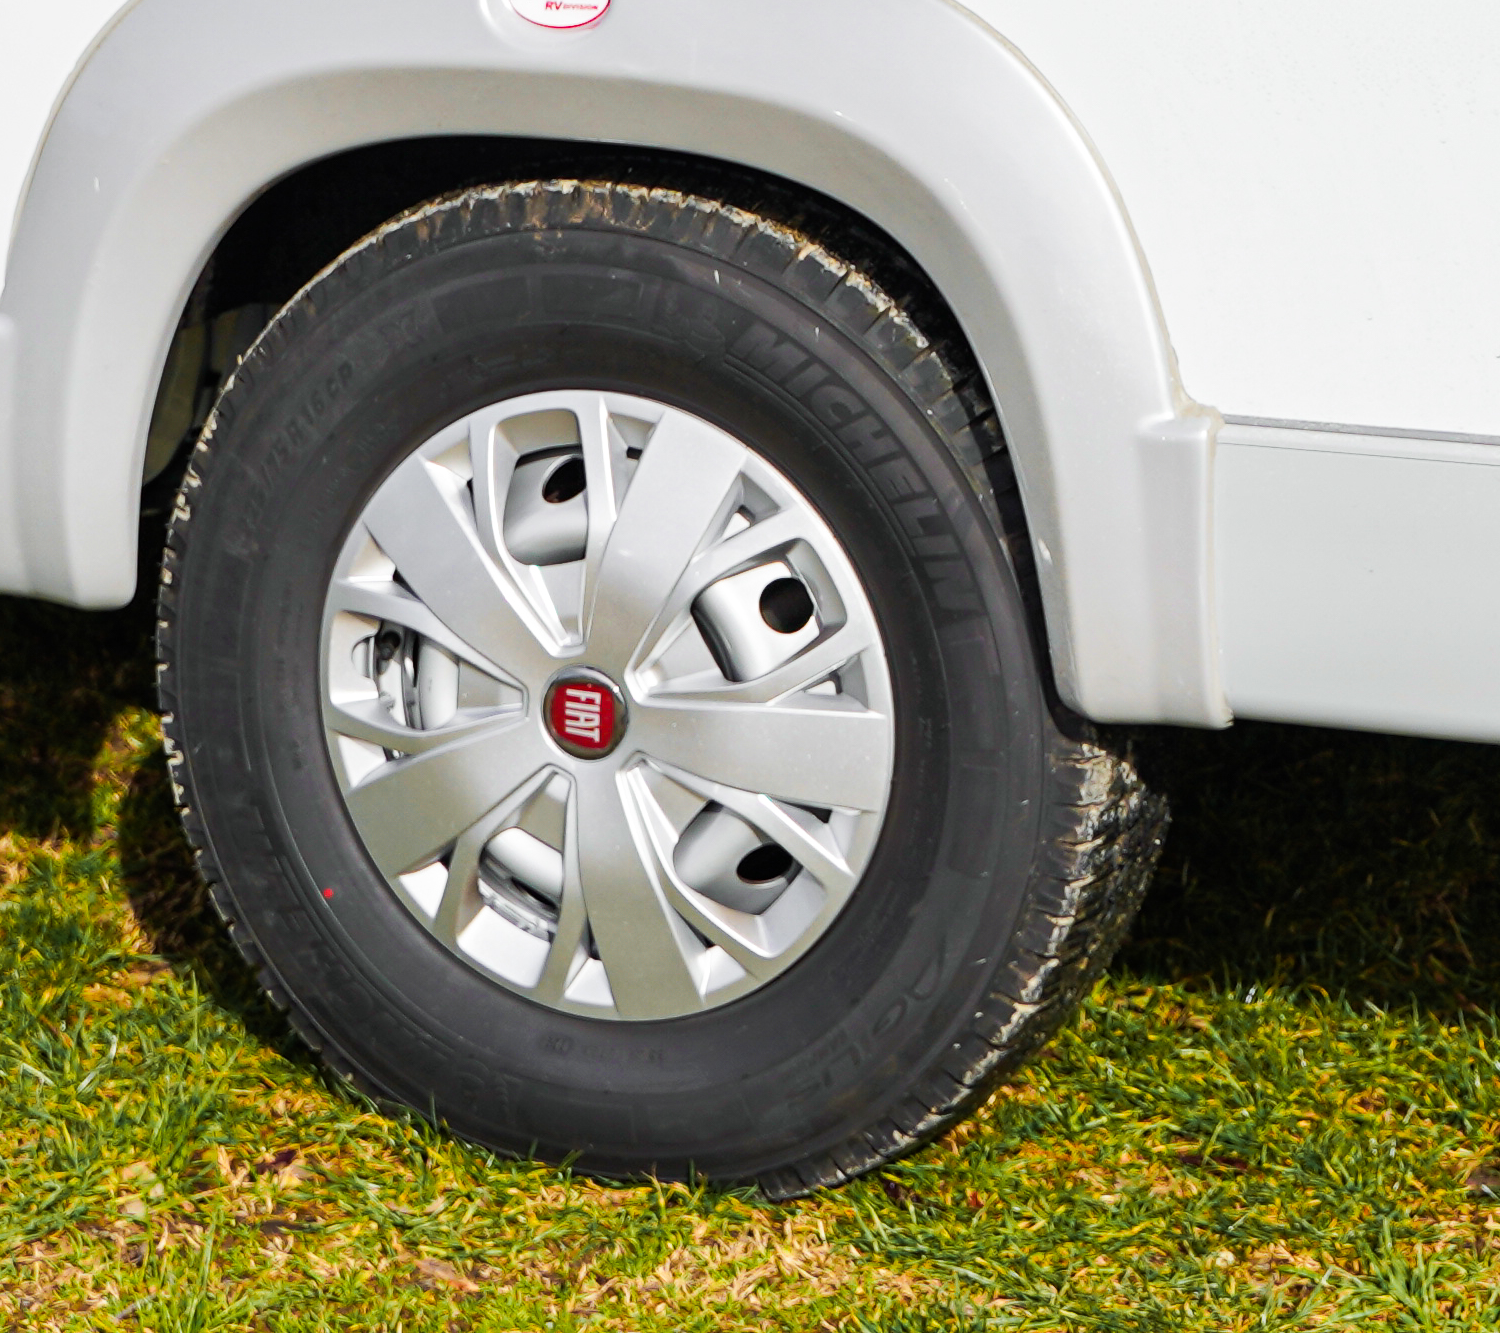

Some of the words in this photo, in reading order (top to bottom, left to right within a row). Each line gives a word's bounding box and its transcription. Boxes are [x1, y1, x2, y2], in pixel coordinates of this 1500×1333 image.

[545, 1, 563, 10] RV
[725, 317, 983, 623] MICHELIN
[564, 688, 602, 744] FIAT
